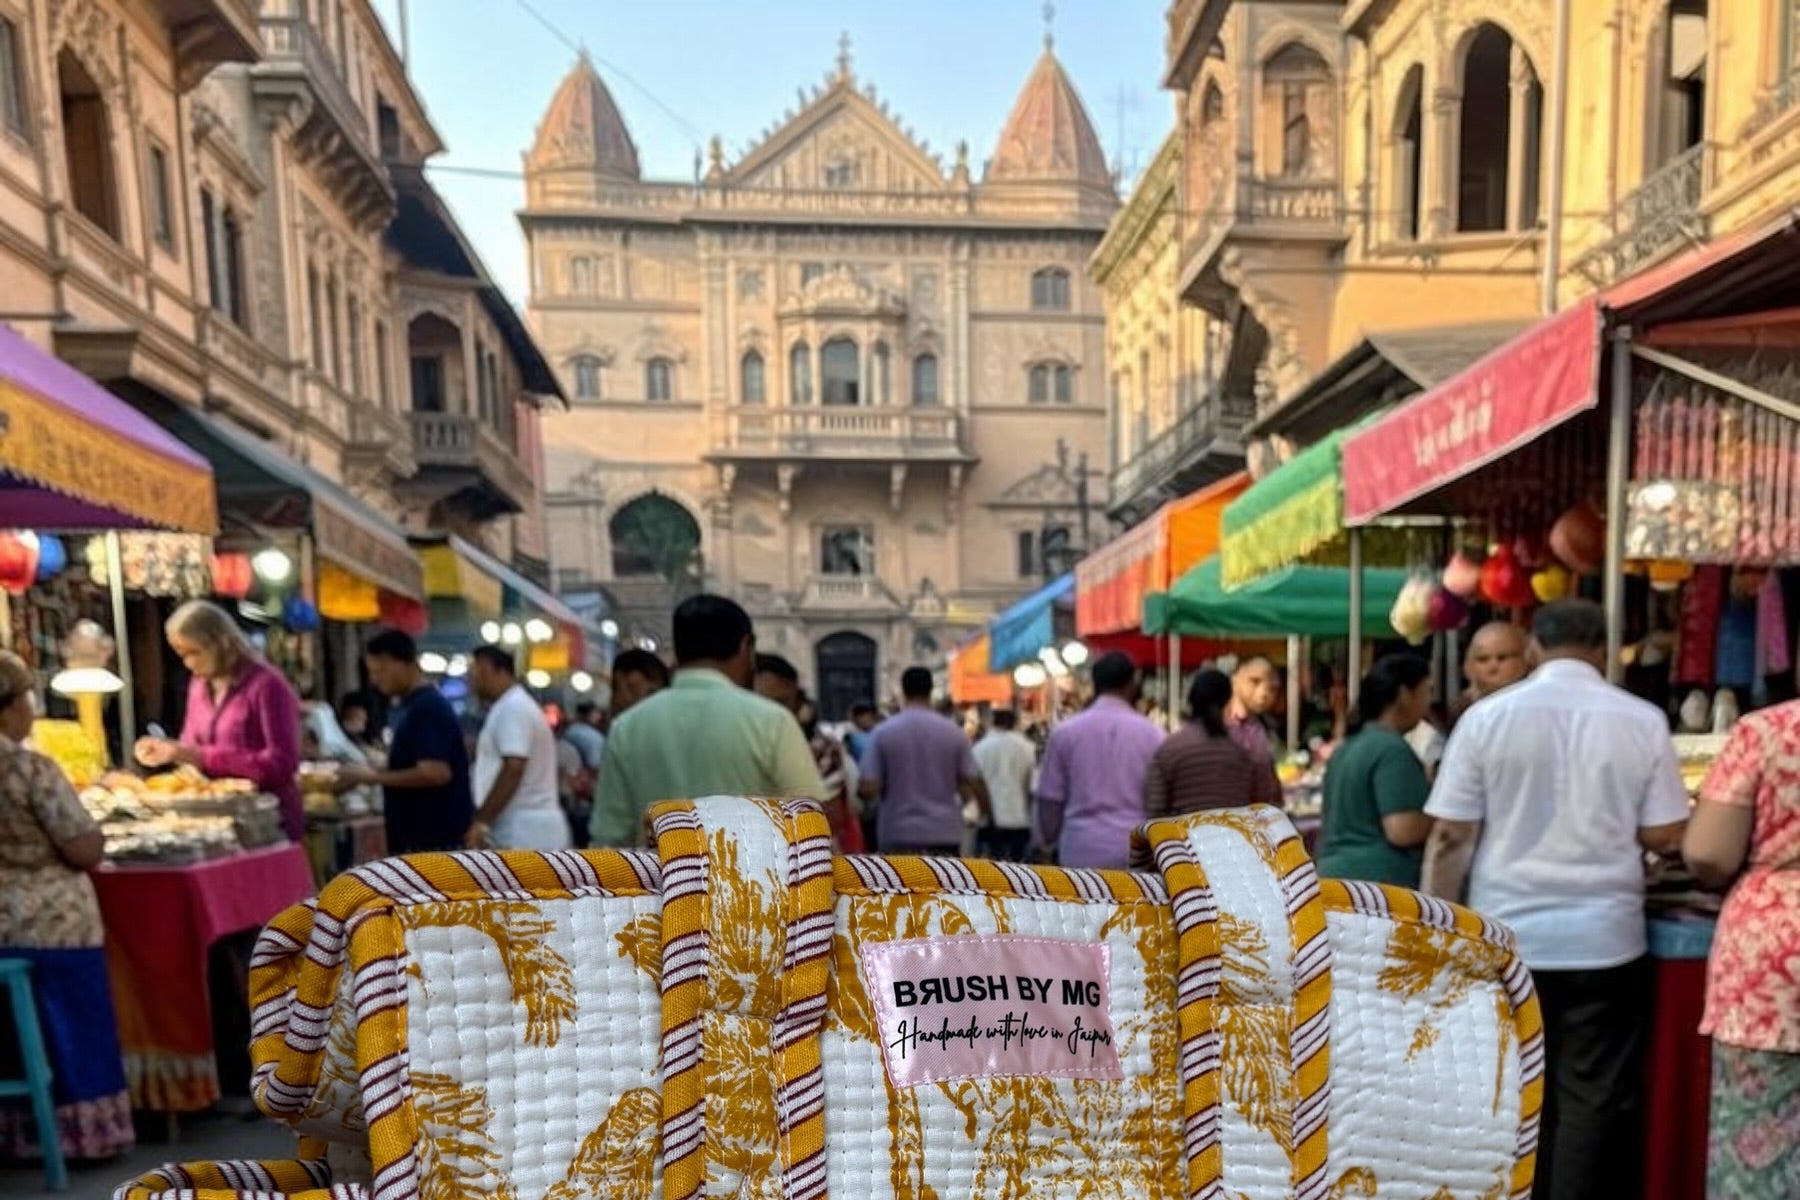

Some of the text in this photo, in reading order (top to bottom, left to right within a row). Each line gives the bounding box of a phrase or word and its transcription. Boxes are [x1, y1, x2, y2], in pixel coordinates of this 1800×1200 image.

[1016, 976, 1053, 1003] BY
[1062, 980, 1100, 1007] MG
[890, 1012, 1111, 1059] Handmade with love in Jaipur
